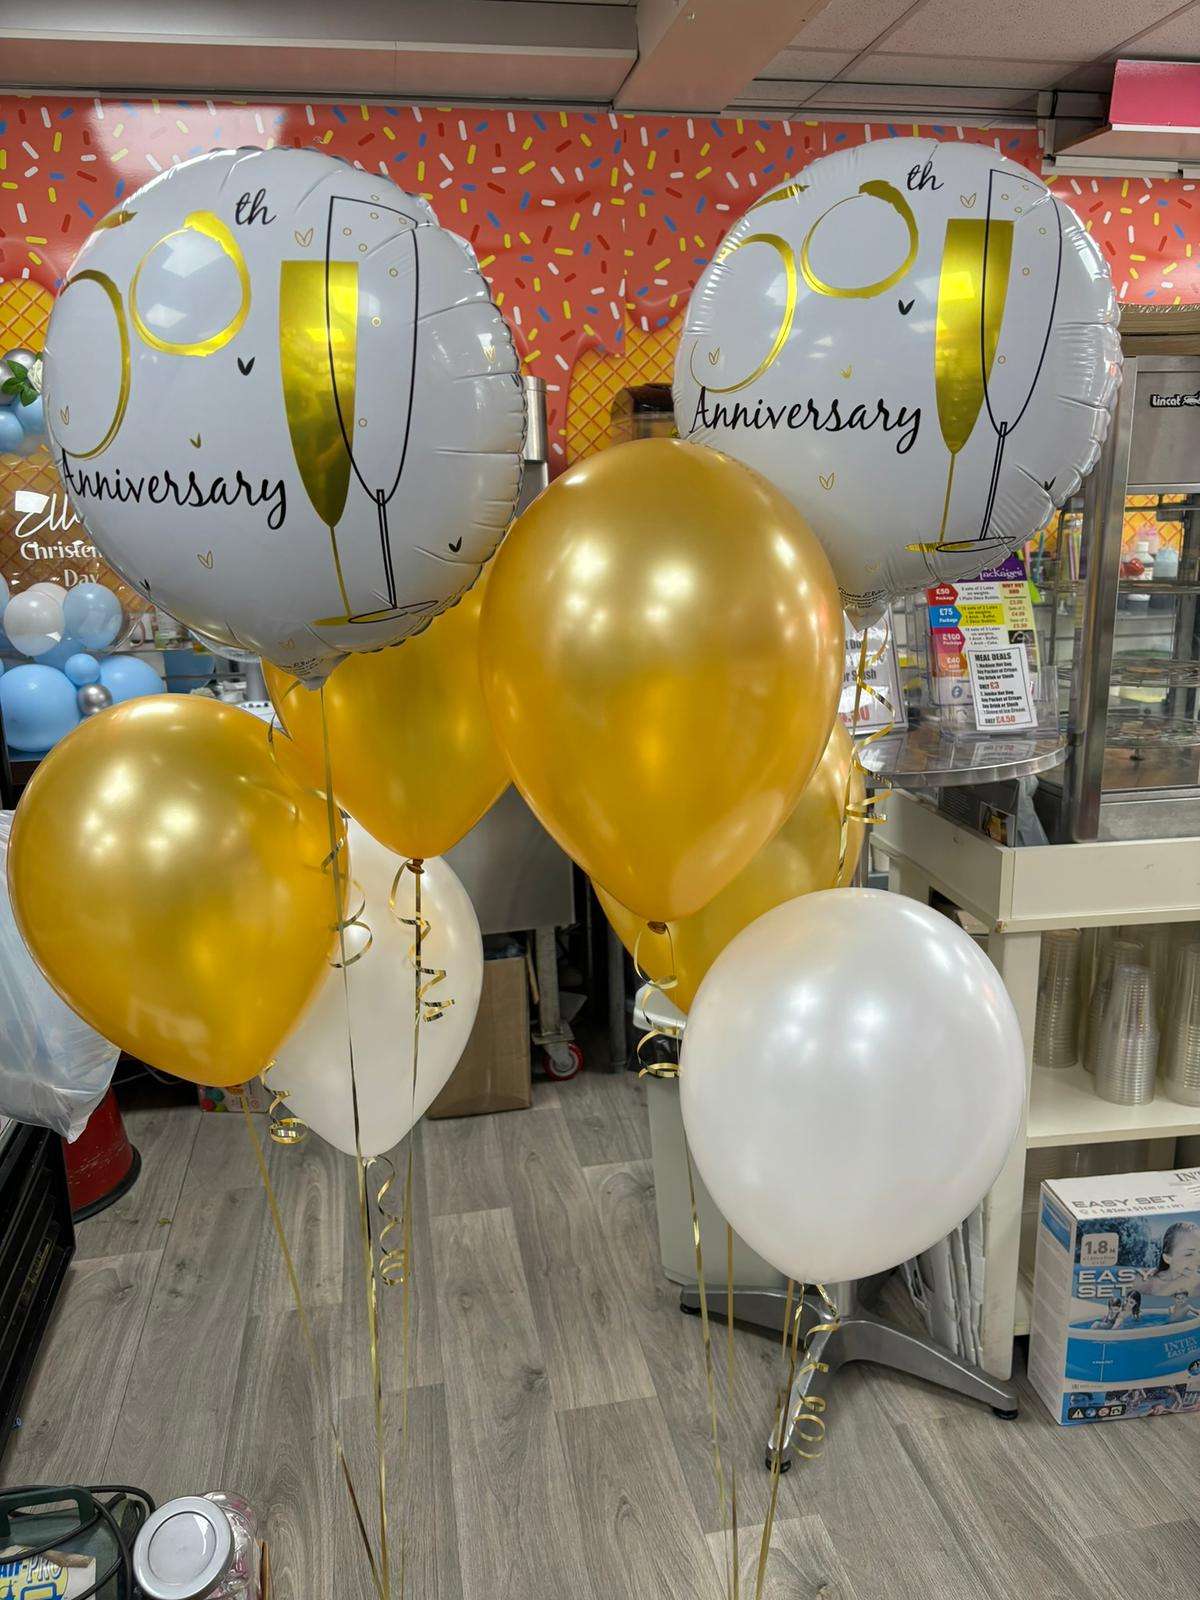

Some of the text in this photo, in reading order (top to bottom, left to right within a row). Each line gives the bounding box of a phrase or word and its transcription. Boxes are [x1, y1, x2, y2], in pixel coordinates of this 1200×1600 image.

[1152, 395, 1181, 406] Lincat
[688, 385, 922, 455] Anniversary
[62, 447, 287, 530] Anniversary
[850, 639, 863, 650] Do
[975, 654, 990, 662] MEAL
[852, 668, 877, 681] Ssh
[1072, 1194, 1177, 1208] EASY SET
[1078, 1268, 1154, 1284] EASY
[1078, 1284, 1134, 1299] SET
